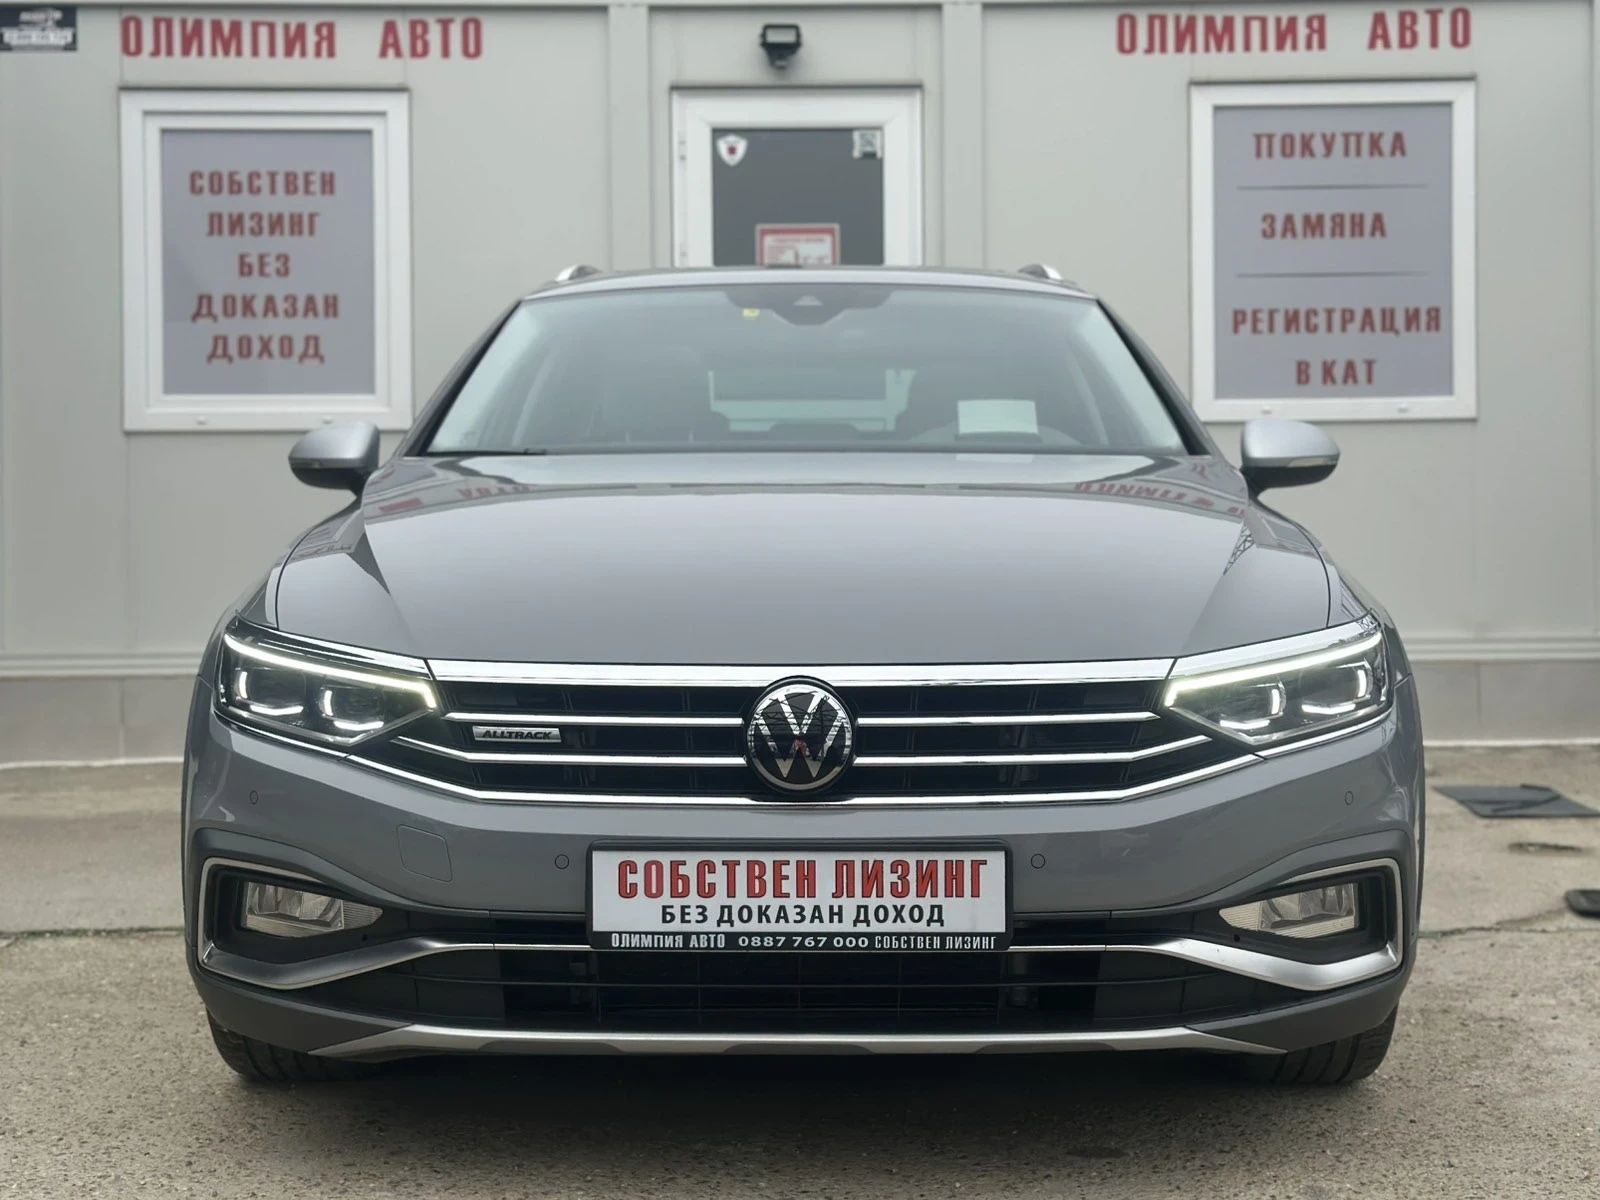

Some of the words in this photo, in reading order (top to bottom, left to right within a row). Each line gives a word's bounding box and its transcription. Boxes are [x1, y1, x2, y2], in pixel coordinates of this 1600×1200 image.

[120, 15, 337, 59] ОЛИМПИЯ
[378, 16, 484, 60] АВТО
[1116, 13, 1328, 55] ОЛИМПИЯ
[1367, 7, 1472, 51] АВТО
[1253, 131, 1407, 159] ПОКУПКА
[189, 170, 336, 197] СОБСТВЕН
[206, 211, 321, 238] ЛИЗИНГ
[1260, 212, 1387, 240] ЗАМЯНА
[237, 252, 291, 278] БЕЗ
[191, 294, 339, 322] ДОКАЗАН
[1232, 306, 1442, 336] РЕГИСТРАЦИЯ
[206, 334, 325, 364] ДОХОД
[1296, 360, 1311, 386] В
[1321, 359, 1377, 385] КАТ
[482, 729, 552, 741] ALLTRACK
[617, 859, 817, 899] СОБСТВЕН
[831, 859, 988, 899] ЛИЗИНГ
[661, 904, 709, 925] БЕЗ
[716, 904, 844, 928] ДОКАЗАН
[852, 904, 946, 928] ДОХОД
[611, 932, 684, 949] ОЛИМПИЯ
[689, 933, 726, 949] АВТО
[738, 936, 786, 948] 0887
[792, 936, 826, 948] 767
[833, 936, 869, 948] 000
[874, 935, 941, 950] СОБСТВЕН
[945, 936, 998, 950] ЛИЗИНГ
